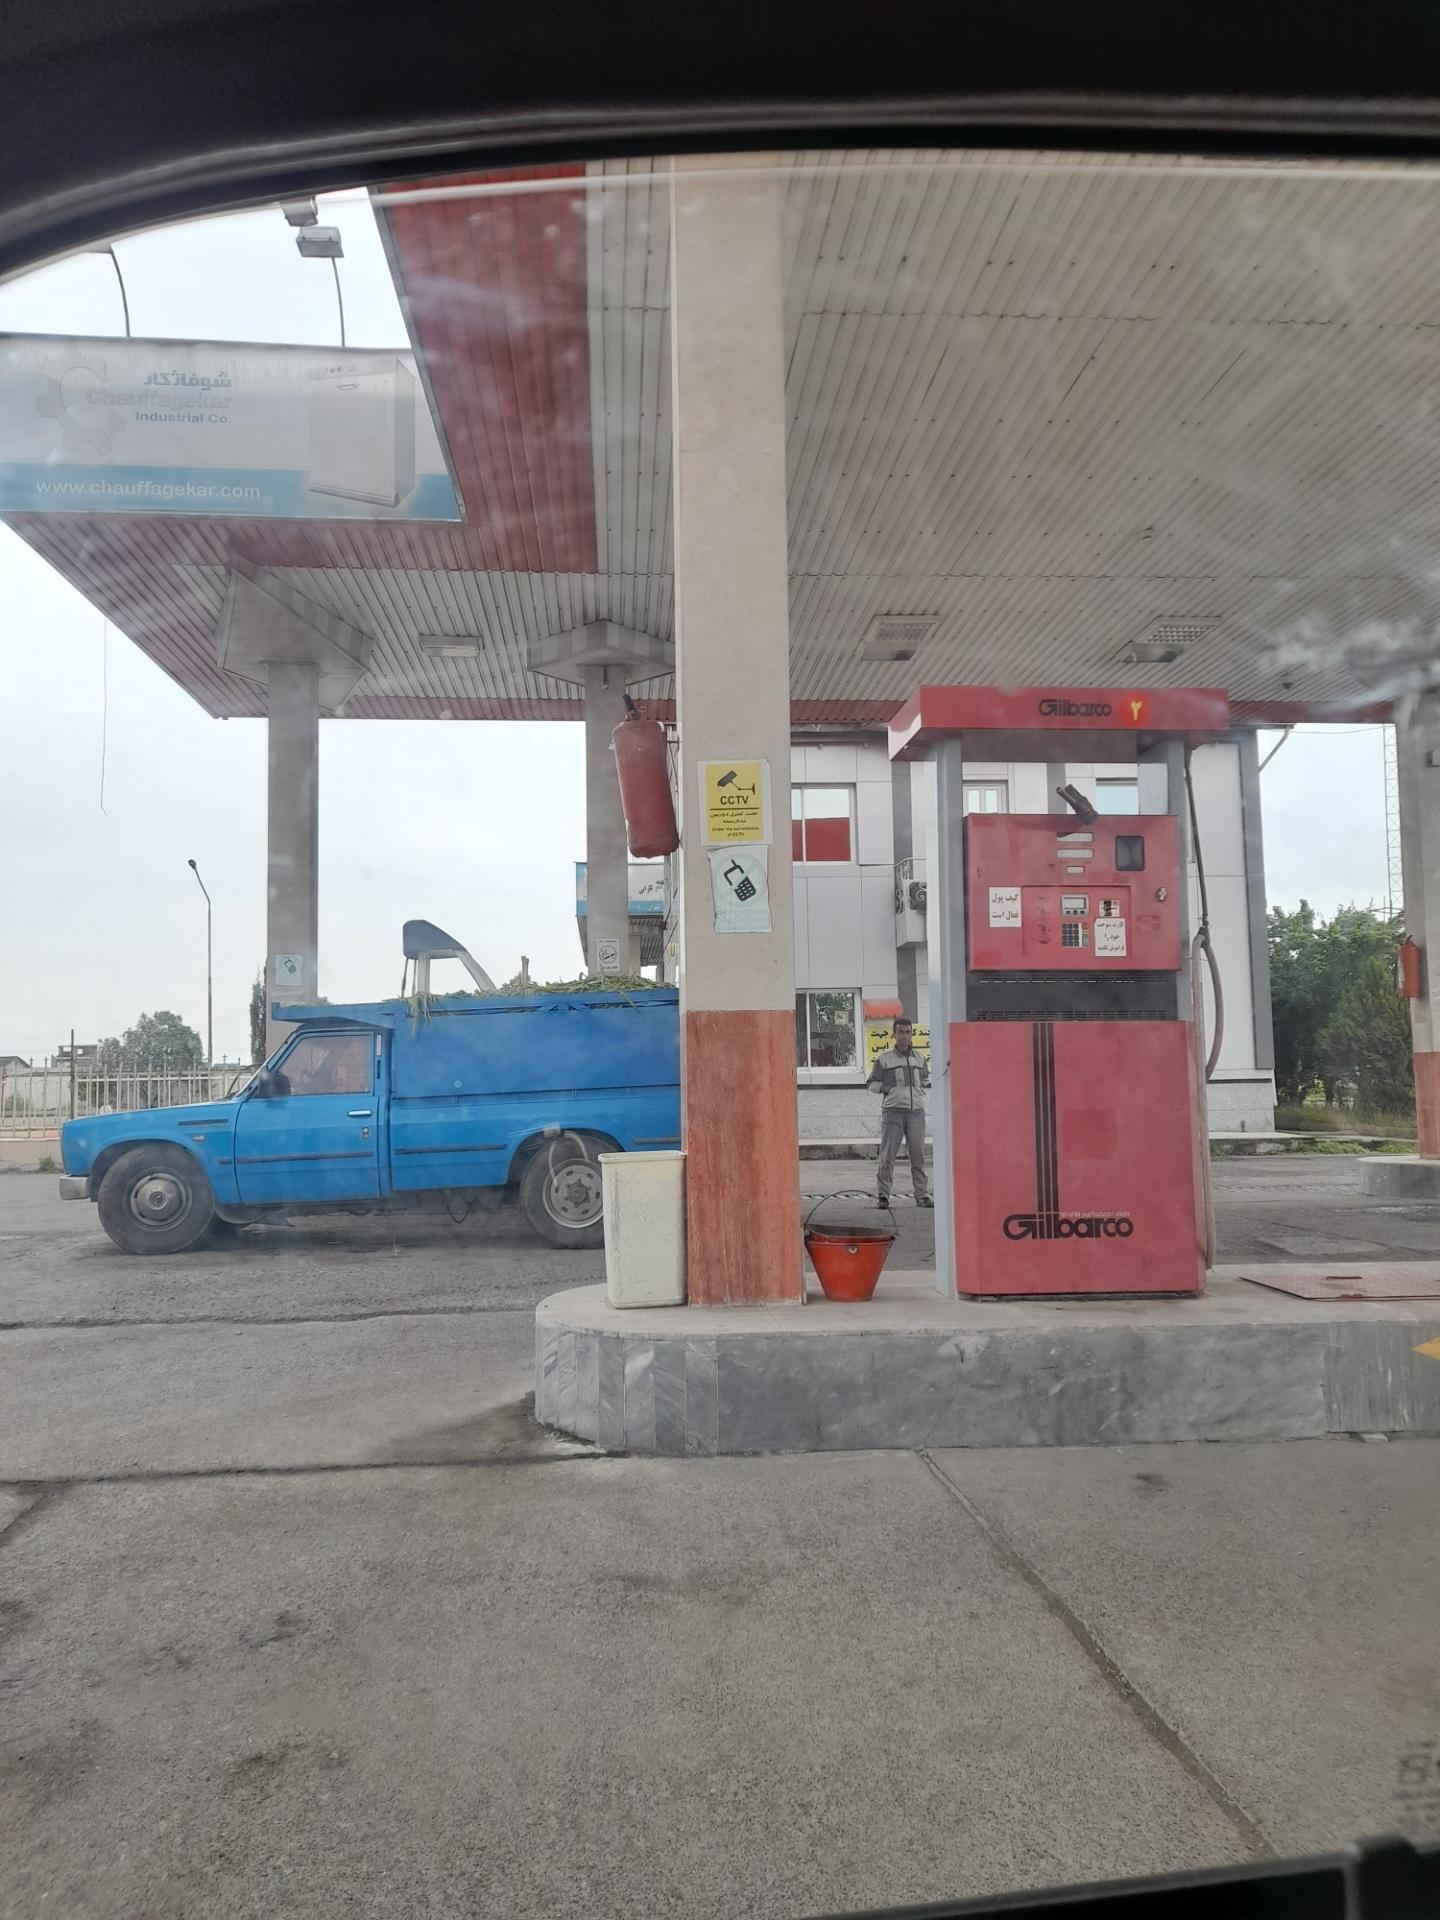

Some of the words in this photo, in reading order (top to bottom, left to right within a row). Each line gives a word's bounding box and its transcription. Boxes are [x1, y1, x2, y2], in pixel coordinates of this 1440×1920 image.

[86, 389, 233, 411] Chauffagekar
[135, 411, 203, 423] Industrial
[207, 413, 232, 424] Co.
[36, 478, 260, 500] www.chauffagekar.com
[1039, 699, 1112, 716] Gilbarco
[720, 795, 749, 805] CCTV
[1003, 1214, 1134, 1240] Gilbarco
